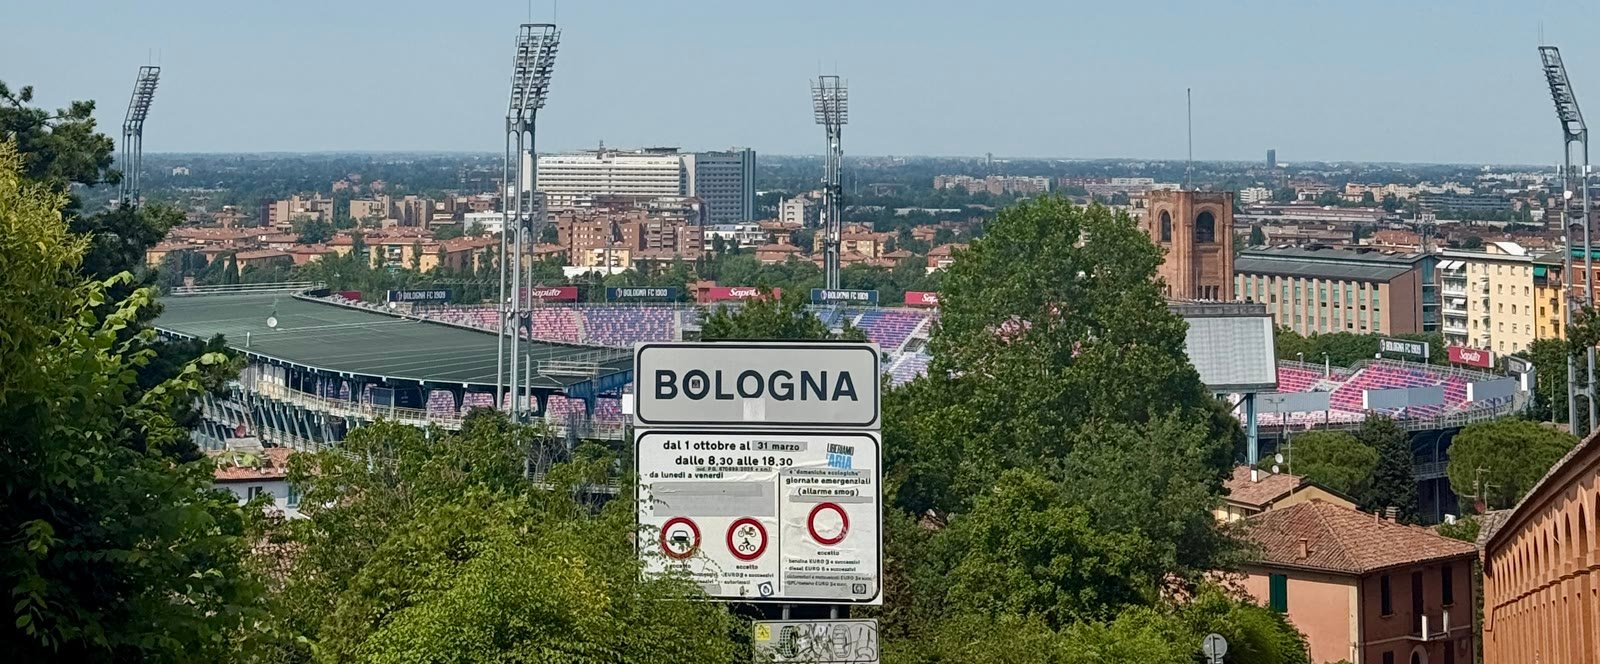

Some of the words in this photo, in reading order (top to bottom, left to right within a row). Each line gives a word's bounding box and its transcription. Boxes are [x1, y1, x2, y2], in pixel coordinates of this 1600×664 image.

[403, 291, 426, 300] BOLOGNA
[426, 290, 433, 299] FC
[434, 290, 446, 299] 1909
[623, 288, 646, 297] BOLOGNA
[647, 288, 654, 296] FC
[827, 291, 850, 299] BOLOGNA
[850, 292, 857, 300] FC
[1386, 341, 1404, 352] BOLOGNA
[655, 369, 858, 402] BOLOGNA
[663, 440, 681, 450] dal
[685, 440, 690, 450] 1
[693, 440, 736, 451] ottobre
[740, 441, 751, 451] al
[757, 442, 768, 450] 31
[772, 443, 800, 451] marzo
[675, 456, 704, 466] dalle
[708, 456, 734, 467] 8.30
[737, 456, 759, 466] alle
[762, 456, 793, 467] 18.30
[798, 488, 832, 496] (allarme
[834, 488, 859, 496] smog)
